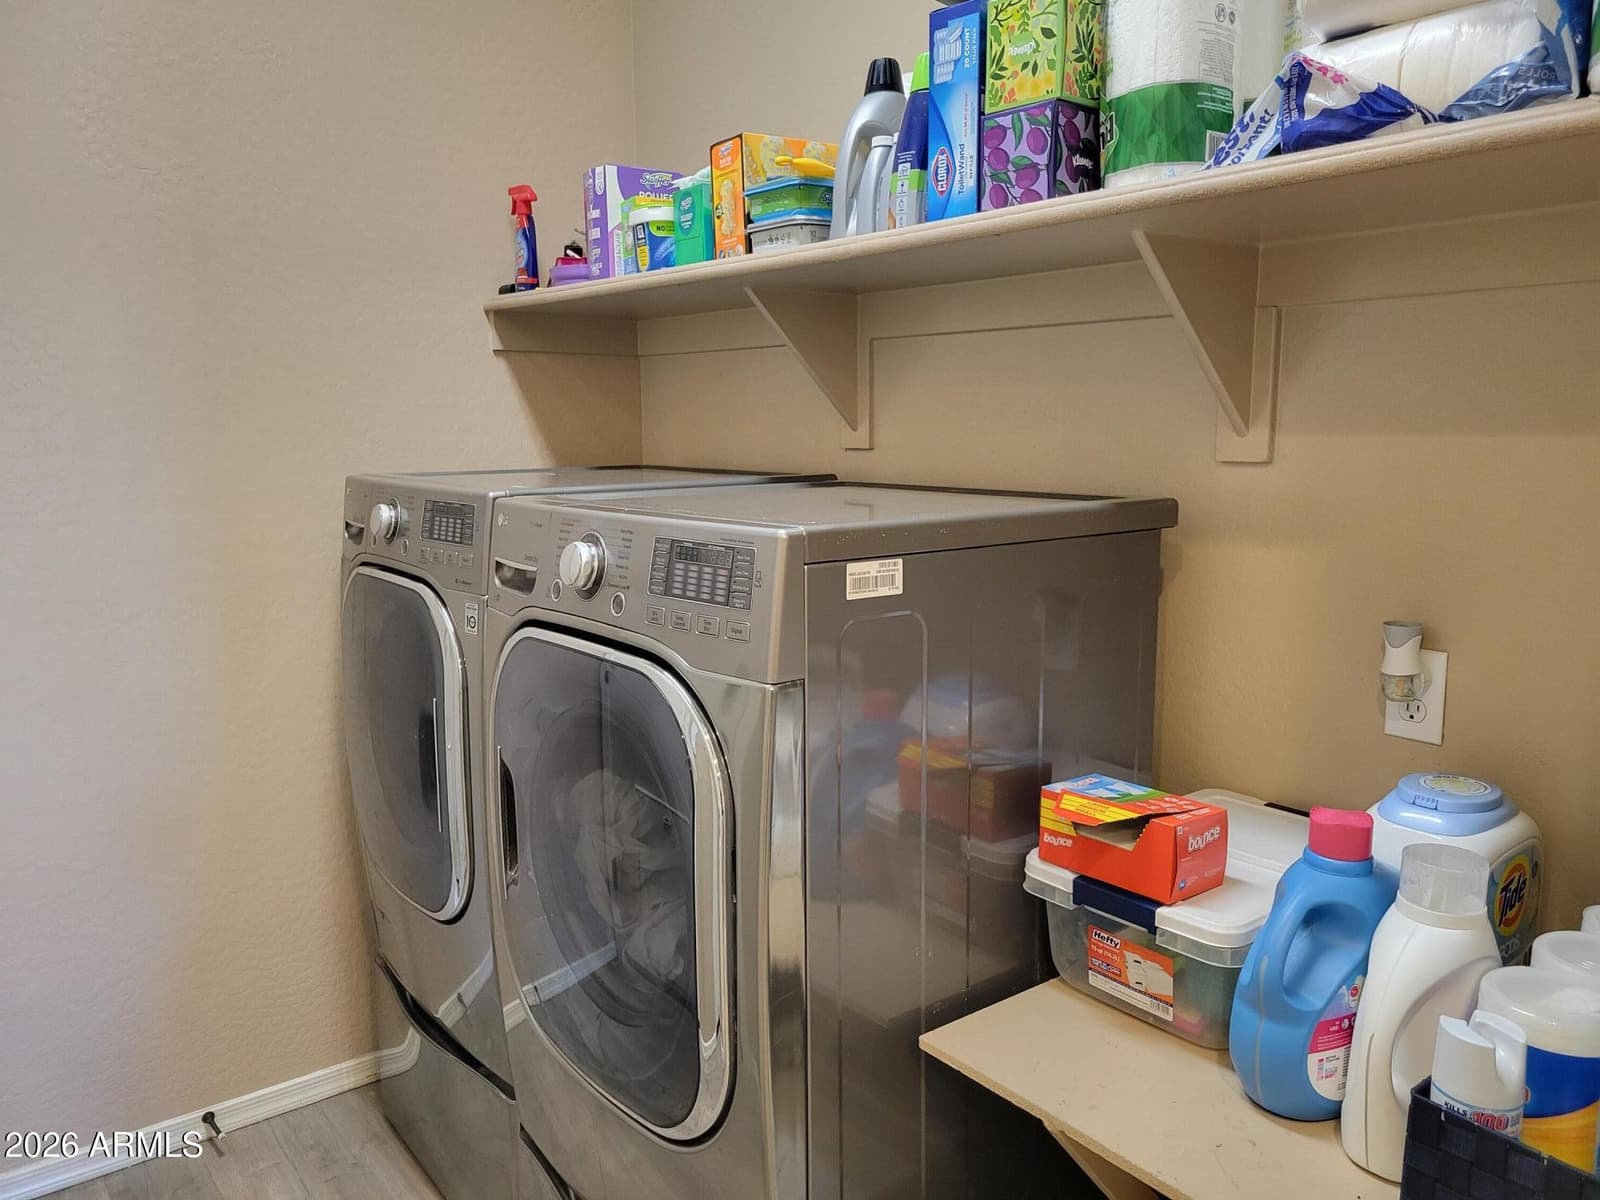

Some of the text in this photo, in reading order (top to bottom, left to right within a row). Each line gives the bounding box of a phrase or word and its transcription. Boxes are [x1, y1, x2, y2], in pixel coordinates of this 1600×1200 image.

[640, 172, 672, 188] Swiffer
[937, 152, 947, 192] CLOROX
[957, 143, 965, 196] ToiletWand
[1043, 832, 1073, 848] bounce
[1187, 824, 1221, 852] bounce
[1498, 871, 1527, 928] Tide
[1094, 930, 1119, 948] Hefty
[1443, 1100, 1467, 1117] KILLS
